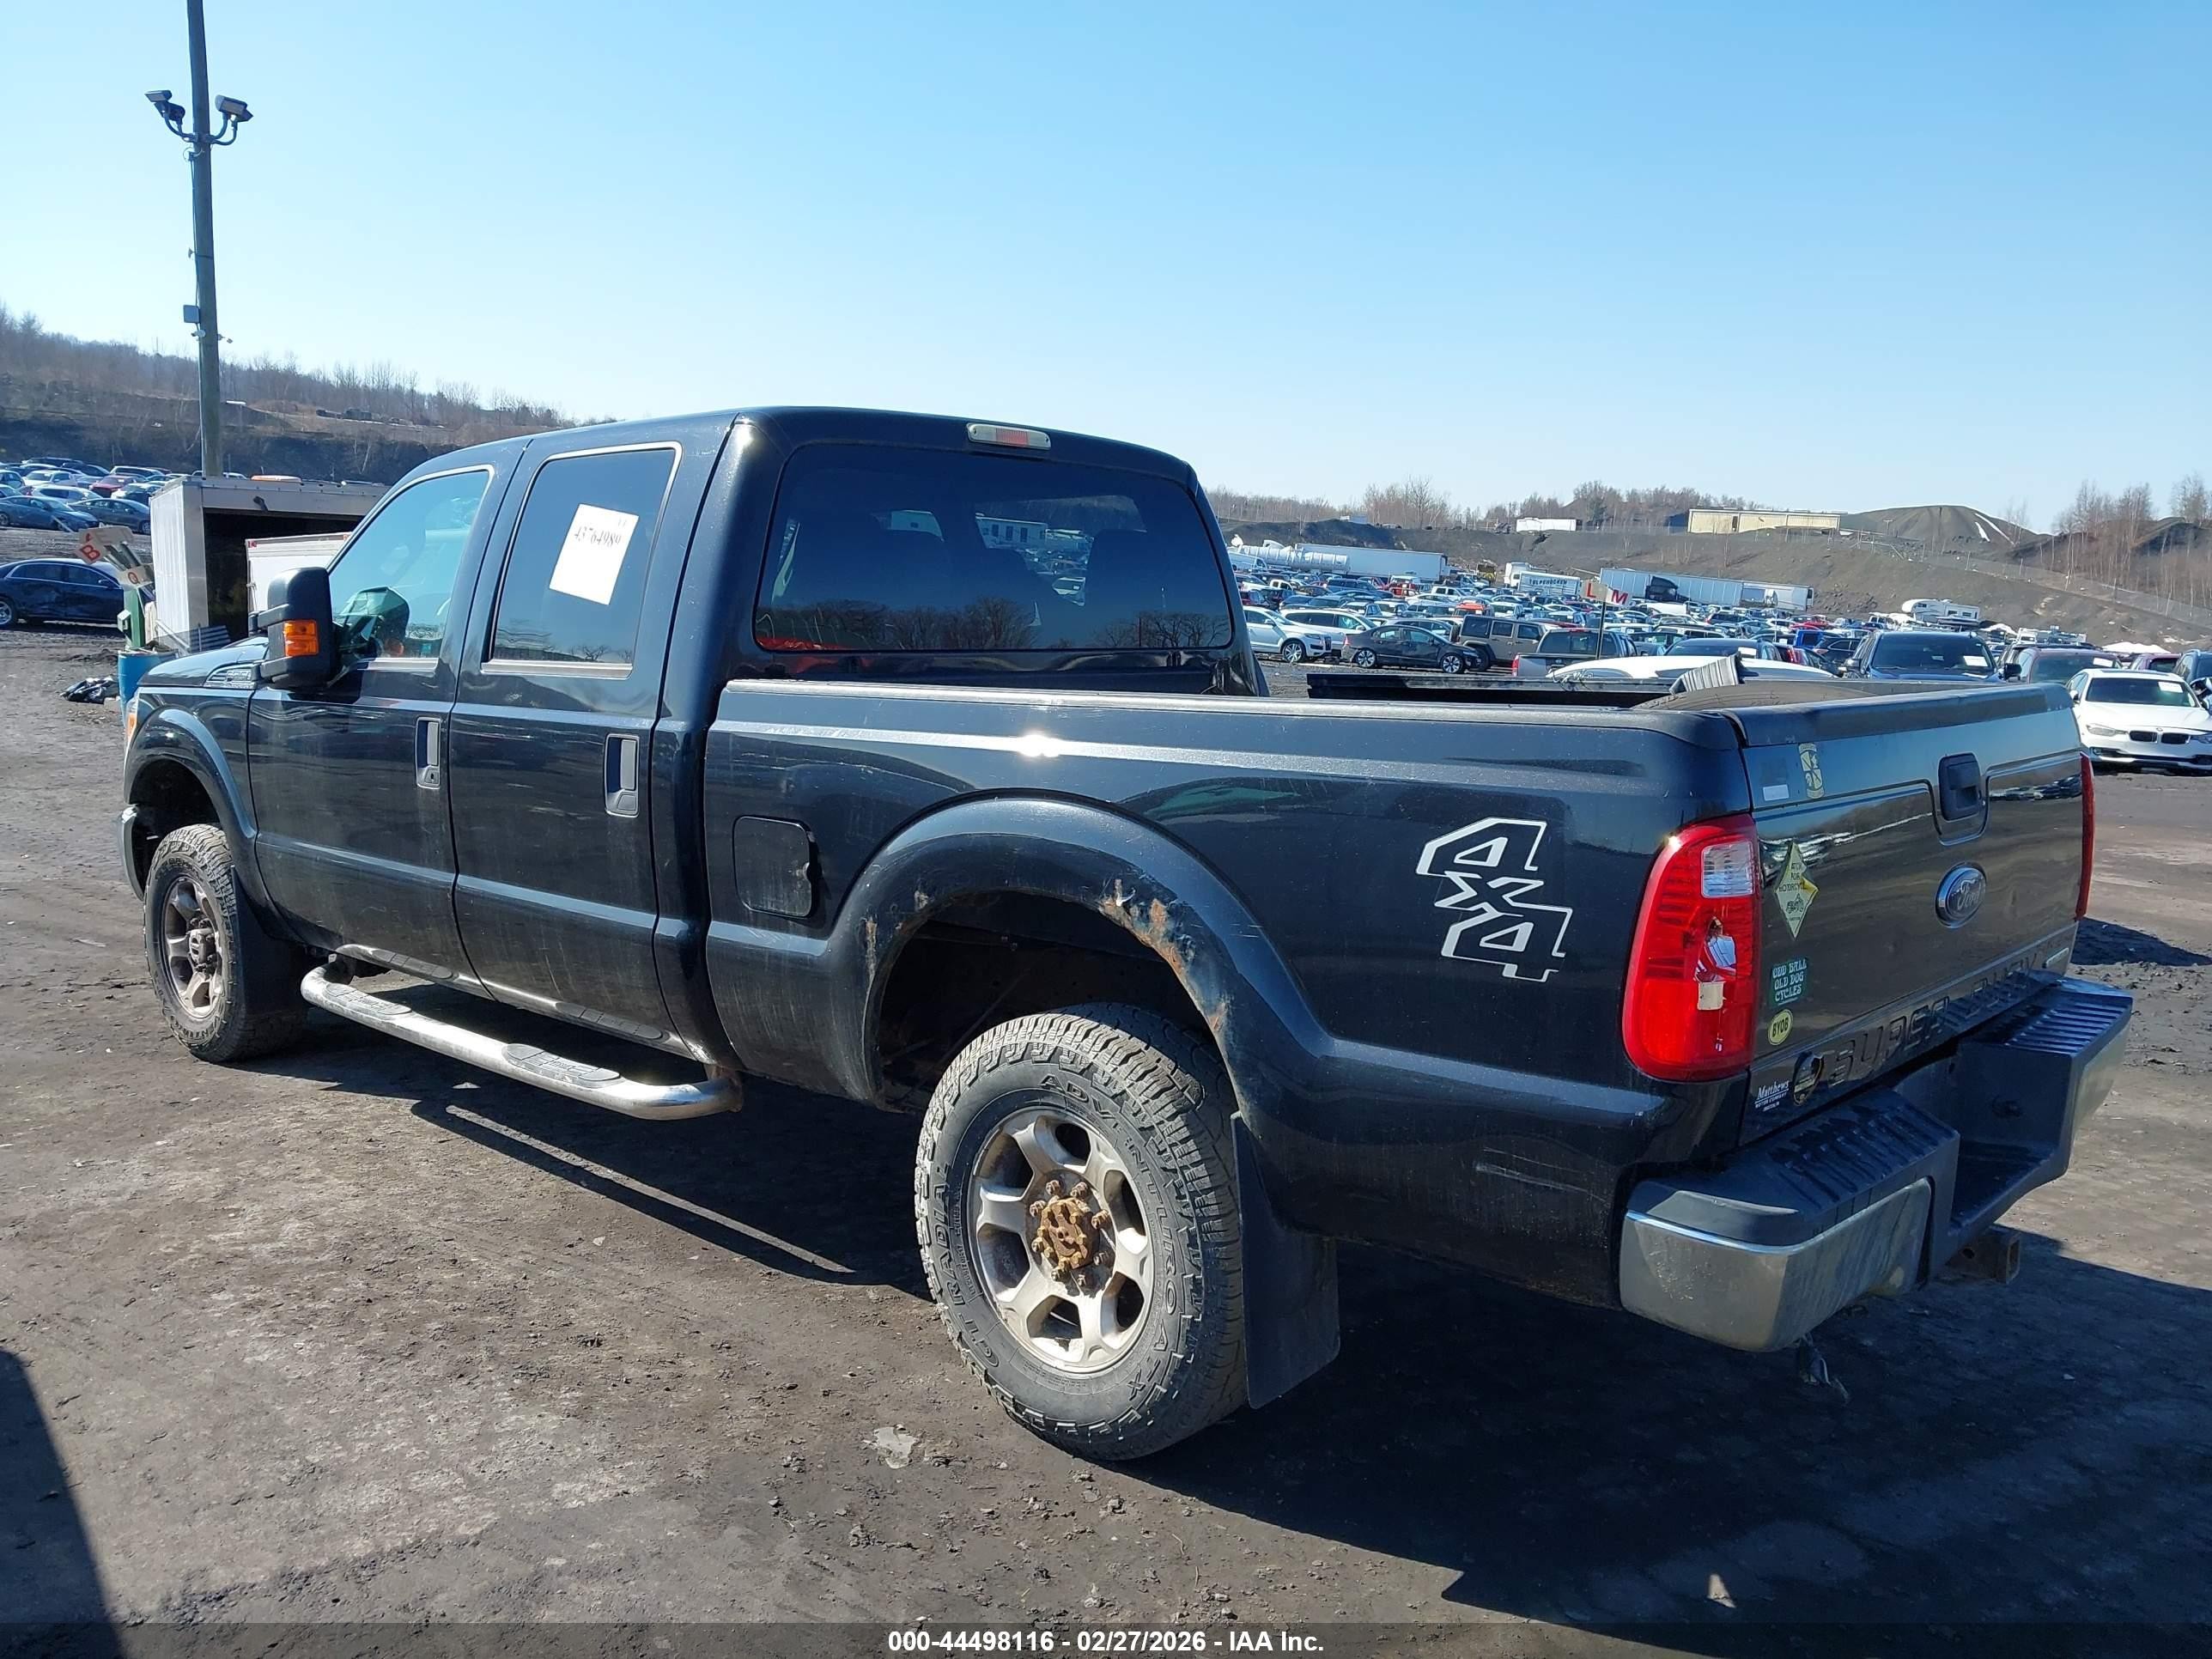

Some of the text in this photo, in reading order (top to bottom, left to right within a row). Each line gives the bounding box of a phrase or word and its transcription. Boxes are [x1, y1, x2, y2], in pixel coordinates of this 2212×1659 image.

[81, 544, 100, 561] B
[1587, 583, 1596, 598] L
[1611, 589, 1629, 605] M
[1772, 958, 1808, 979] ODD BALL
[1774, 971, 1804, 990] OLD DOG
[1775, 984, 1802, 1001] CYCLES
[1771, 1017, 1789, 1037] BYOB
[1757, 1080, 1790, 1099] Matthews
